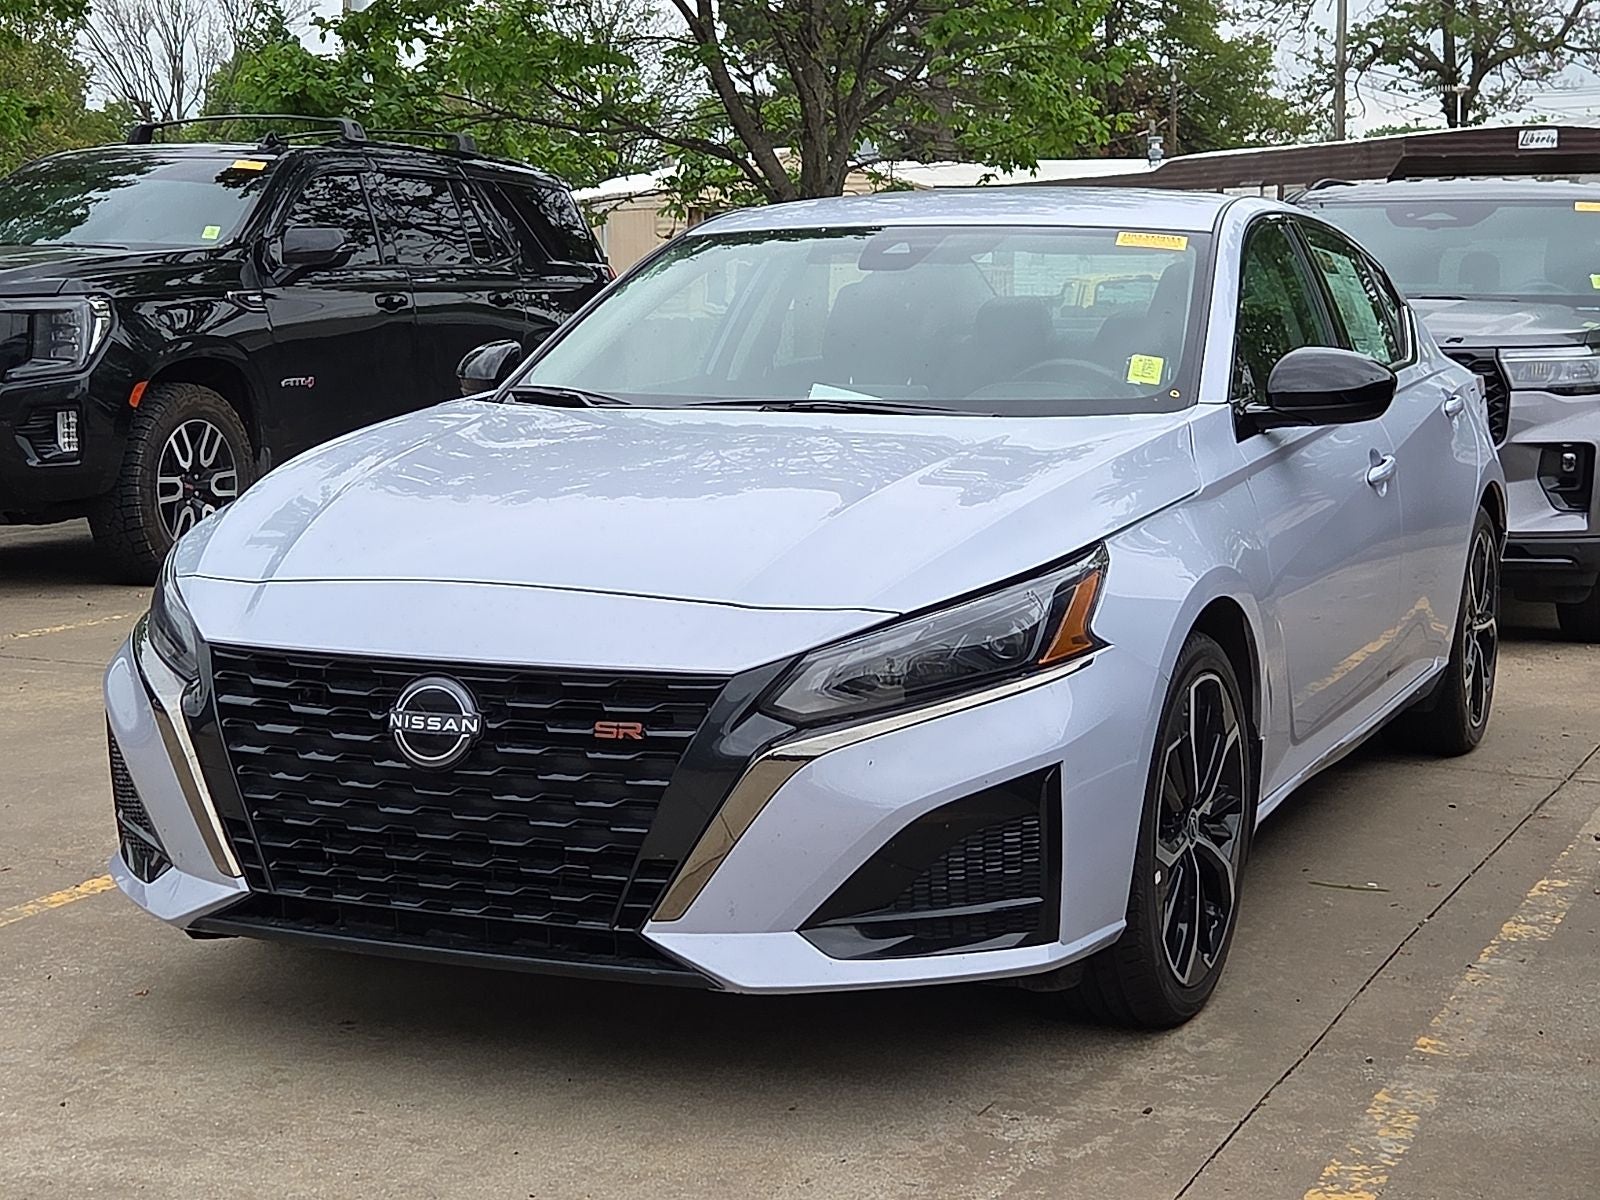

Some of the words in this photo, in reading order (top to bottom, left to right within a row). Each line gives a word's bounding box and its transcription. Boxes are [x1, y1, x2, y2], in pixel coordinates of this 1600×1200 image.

[1520, 130, 1556, 146] Liberty
[389, 713, 478, 732] NISSAN
[594, 721, 643, 739] SR
